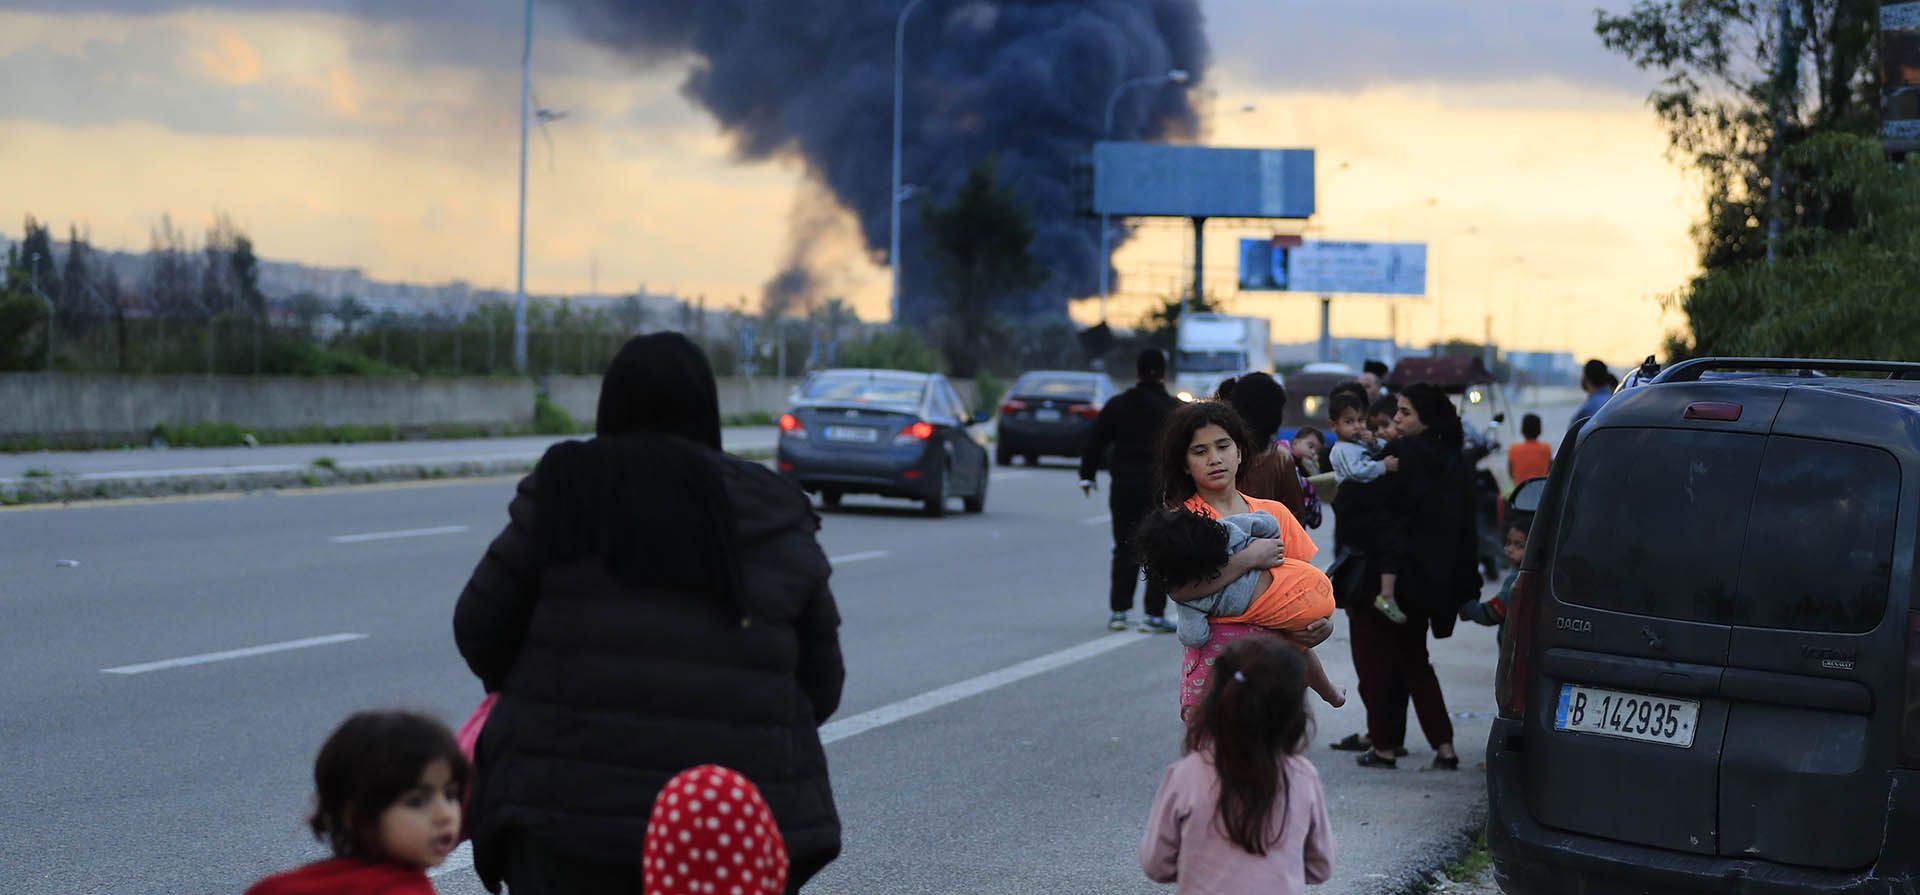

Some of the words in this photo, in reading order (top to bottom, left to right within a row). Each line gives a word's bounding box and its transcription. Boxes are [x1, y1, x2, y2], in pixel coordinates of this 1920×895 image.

[1556, 617, 1592, 632] DACIA
[1572, 692, 1587, 725] B
[1601, 695, 1681, 738] 142935
